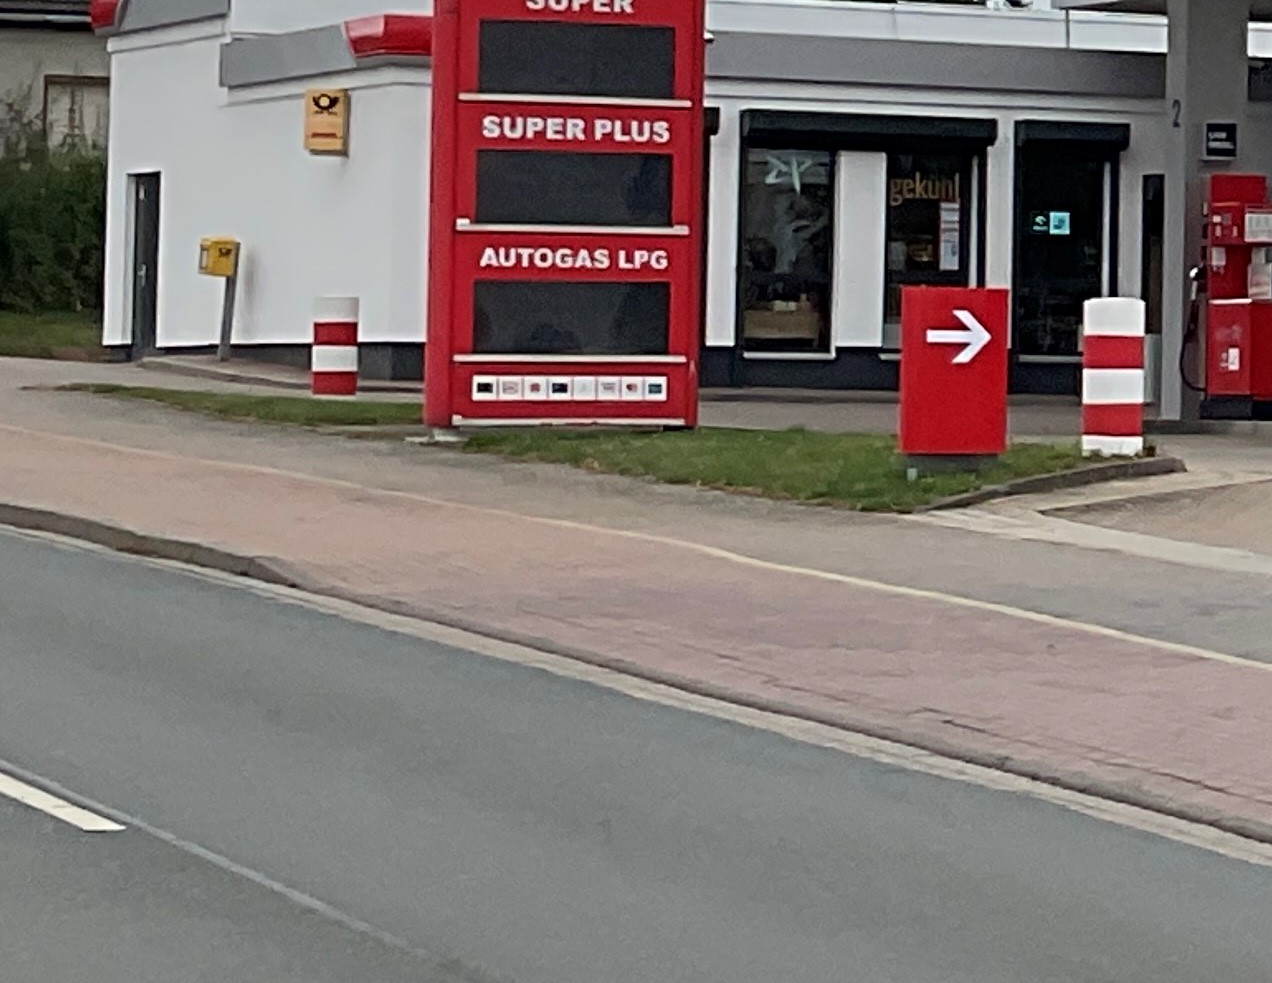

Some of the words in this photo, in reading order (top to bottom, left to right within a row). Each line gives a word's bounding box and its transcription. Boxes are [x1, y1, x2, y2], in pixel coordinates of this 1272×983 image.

[1172, 99, 1181, 127] 2
[482, 115, 584, 141] SUPER
[595, 118, 671, 144] PLUS
[479, 247, 609, 270] AUTOGAS
[618, 248, 668, 270] LPG
